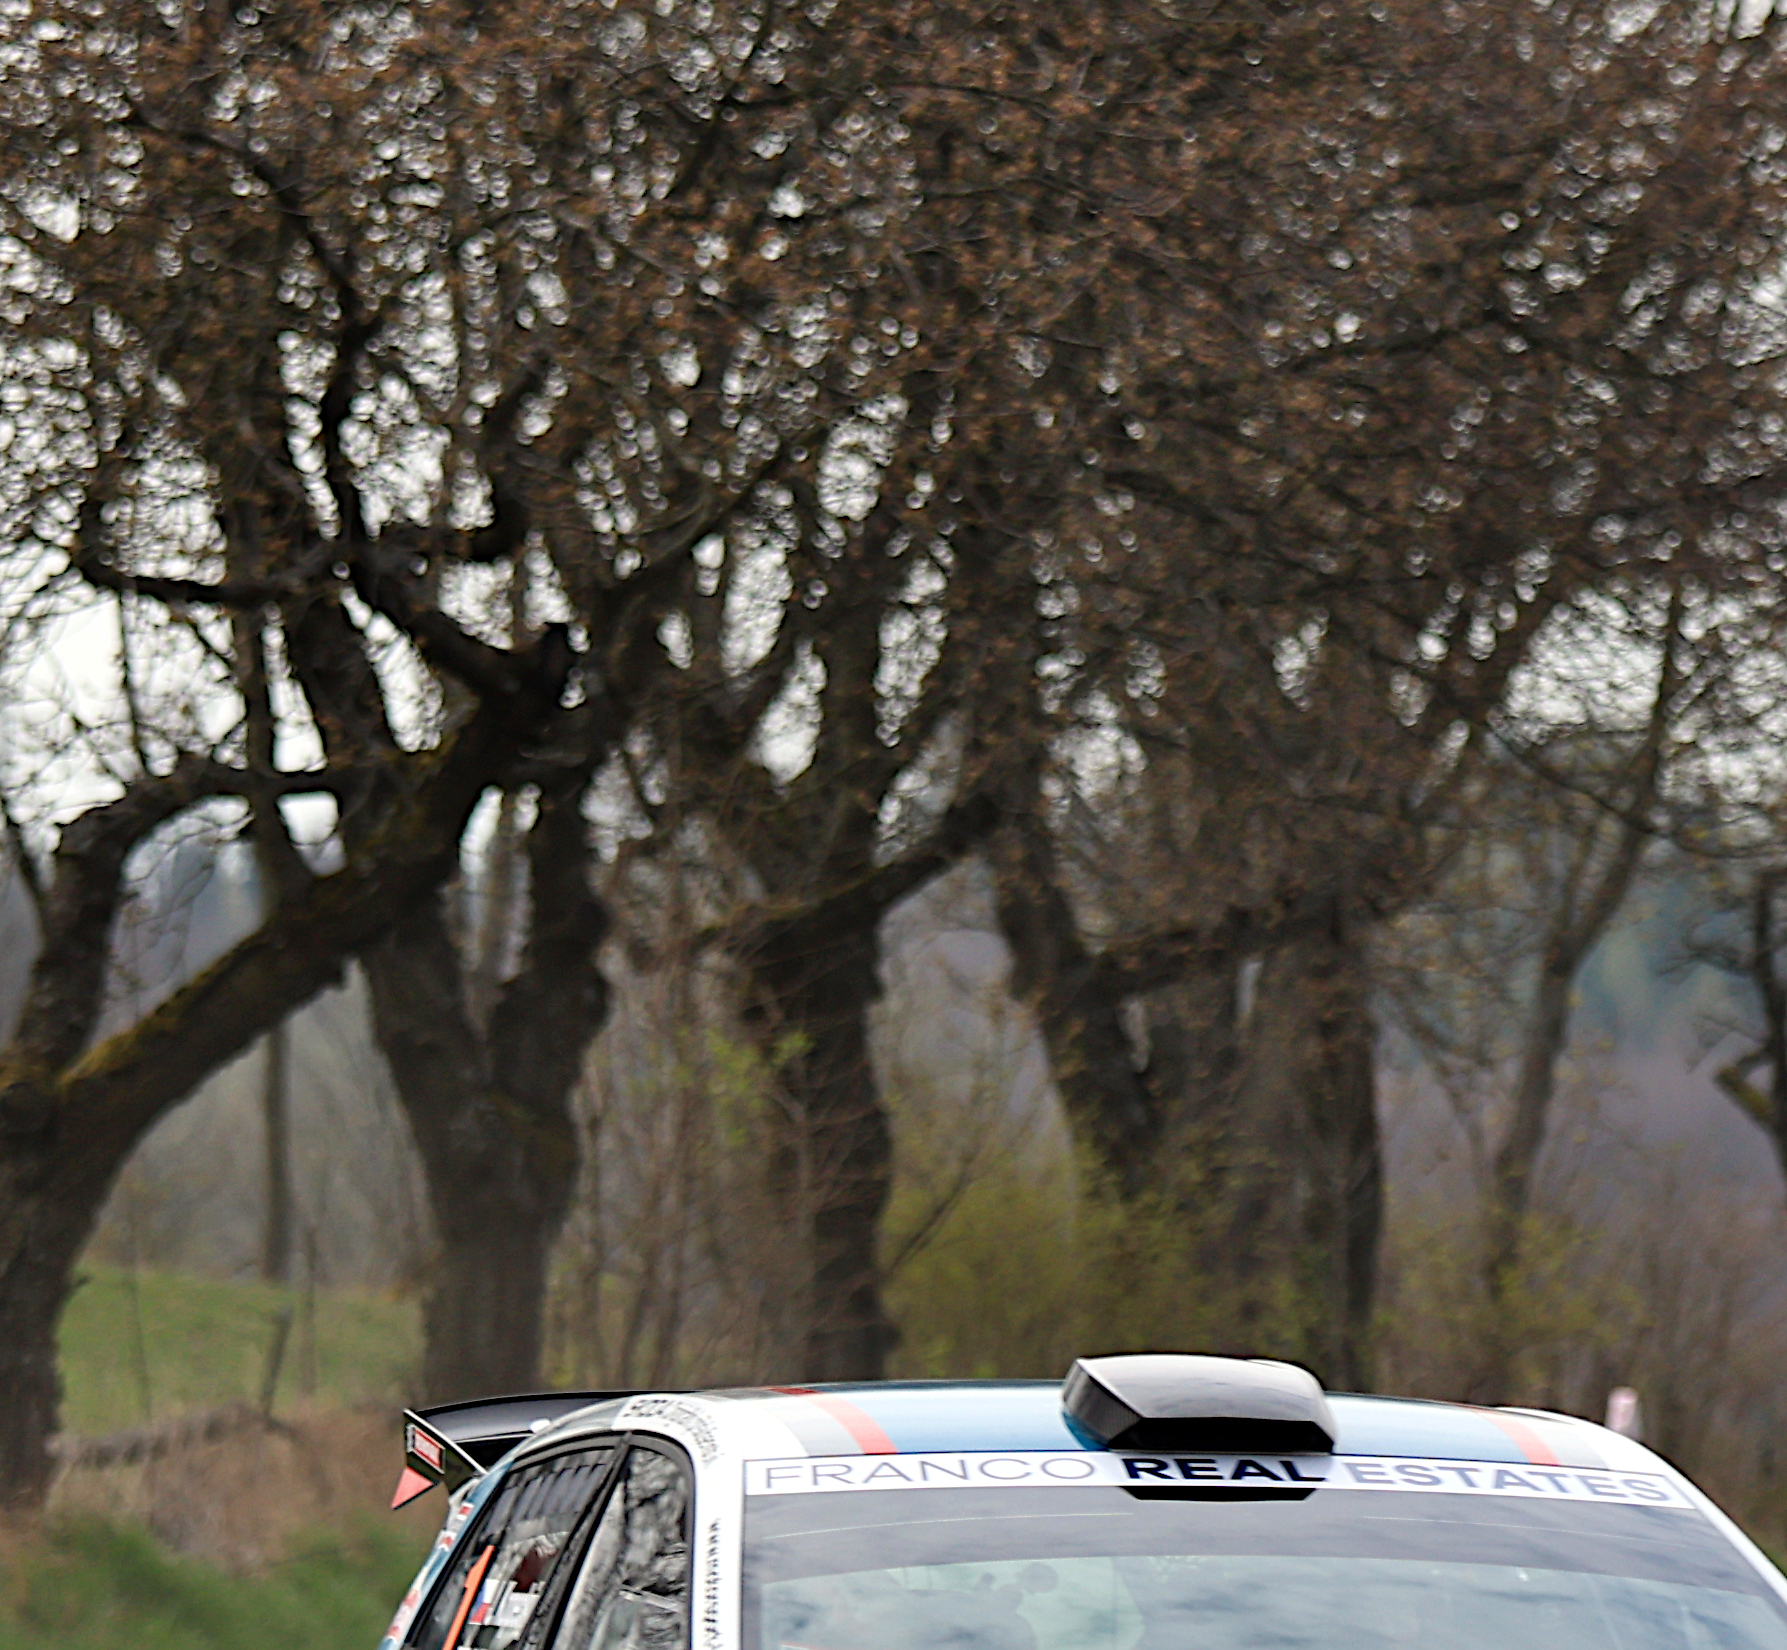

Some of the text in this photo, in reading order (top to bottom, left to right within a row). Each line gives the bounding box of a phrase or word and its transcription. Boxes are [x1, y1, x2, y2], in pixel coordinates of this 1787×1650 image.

[765, 1457, 1673, 1503] FRANCO REAL ESTATES
